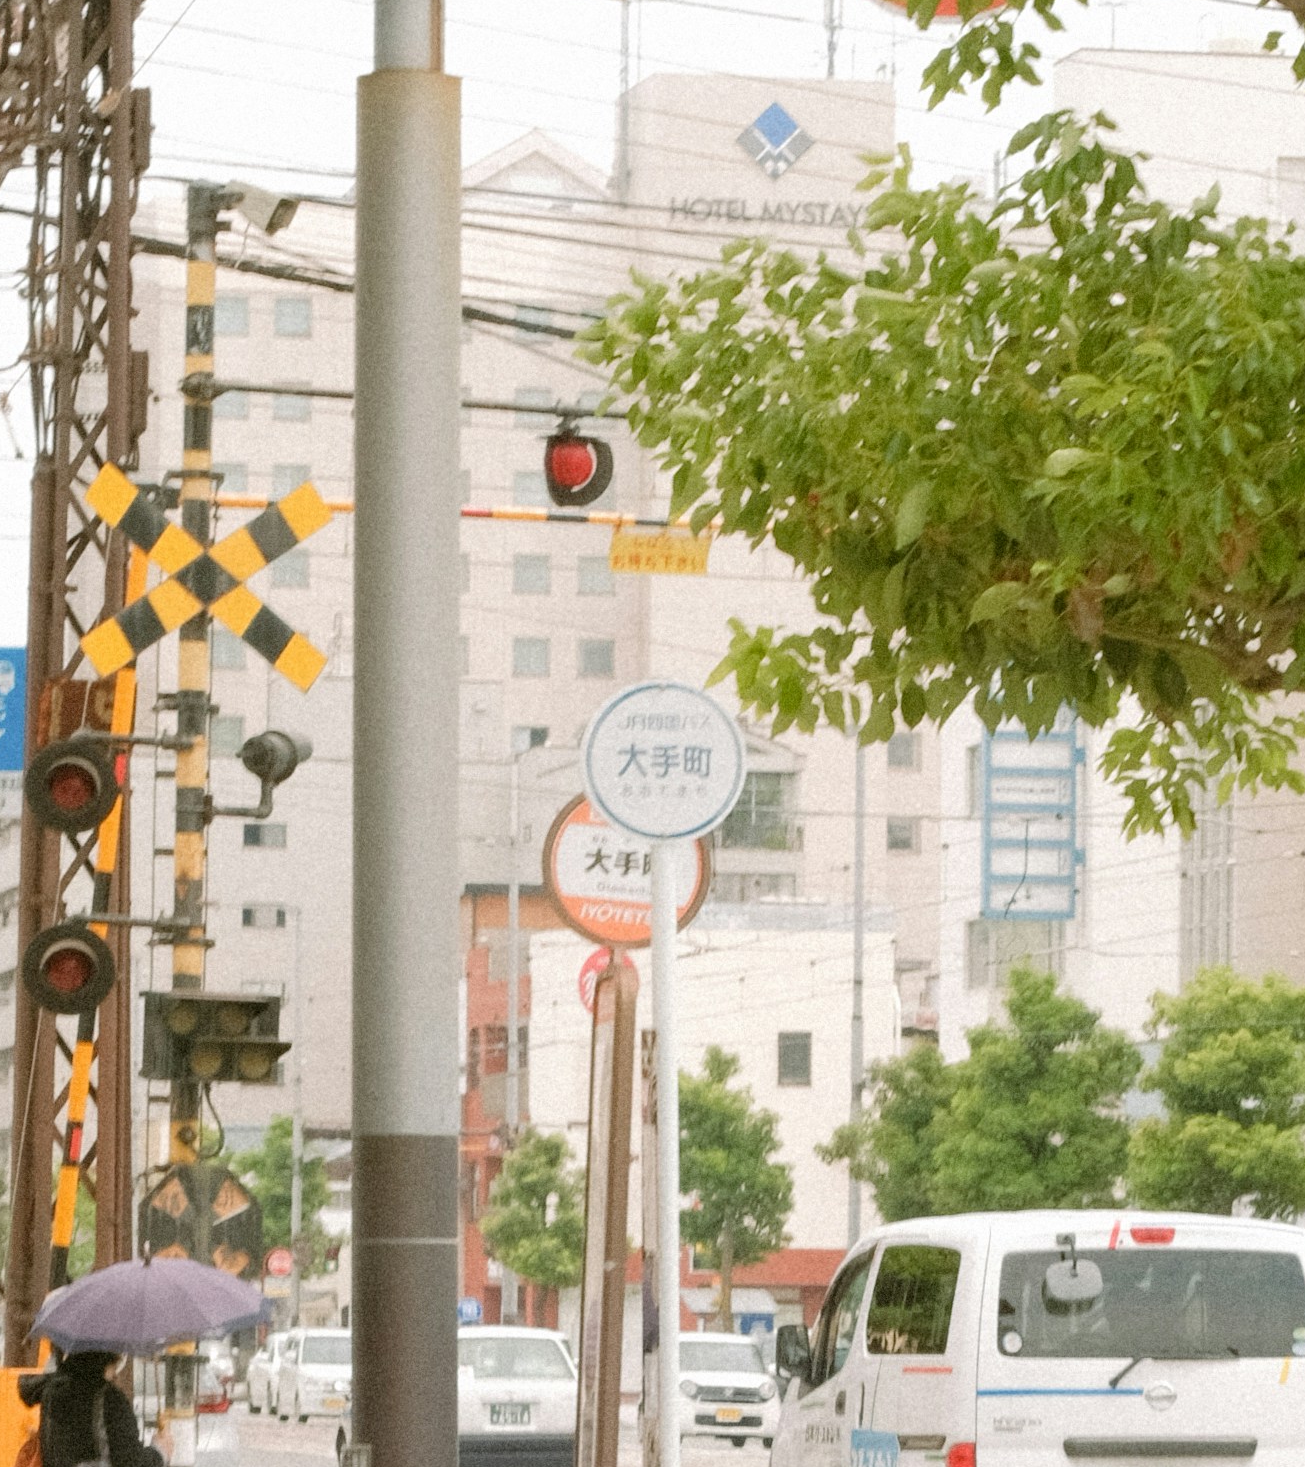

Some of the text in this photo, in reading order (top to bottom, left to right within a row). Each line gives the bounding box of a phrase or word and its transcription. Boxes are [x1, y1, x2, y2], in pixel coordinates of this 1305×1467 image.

[668, 197, 868, 228] HOTEL MYSTAY
[618, 742, 712, 780] 大手町
[585, 848, 651, 876] 大手
